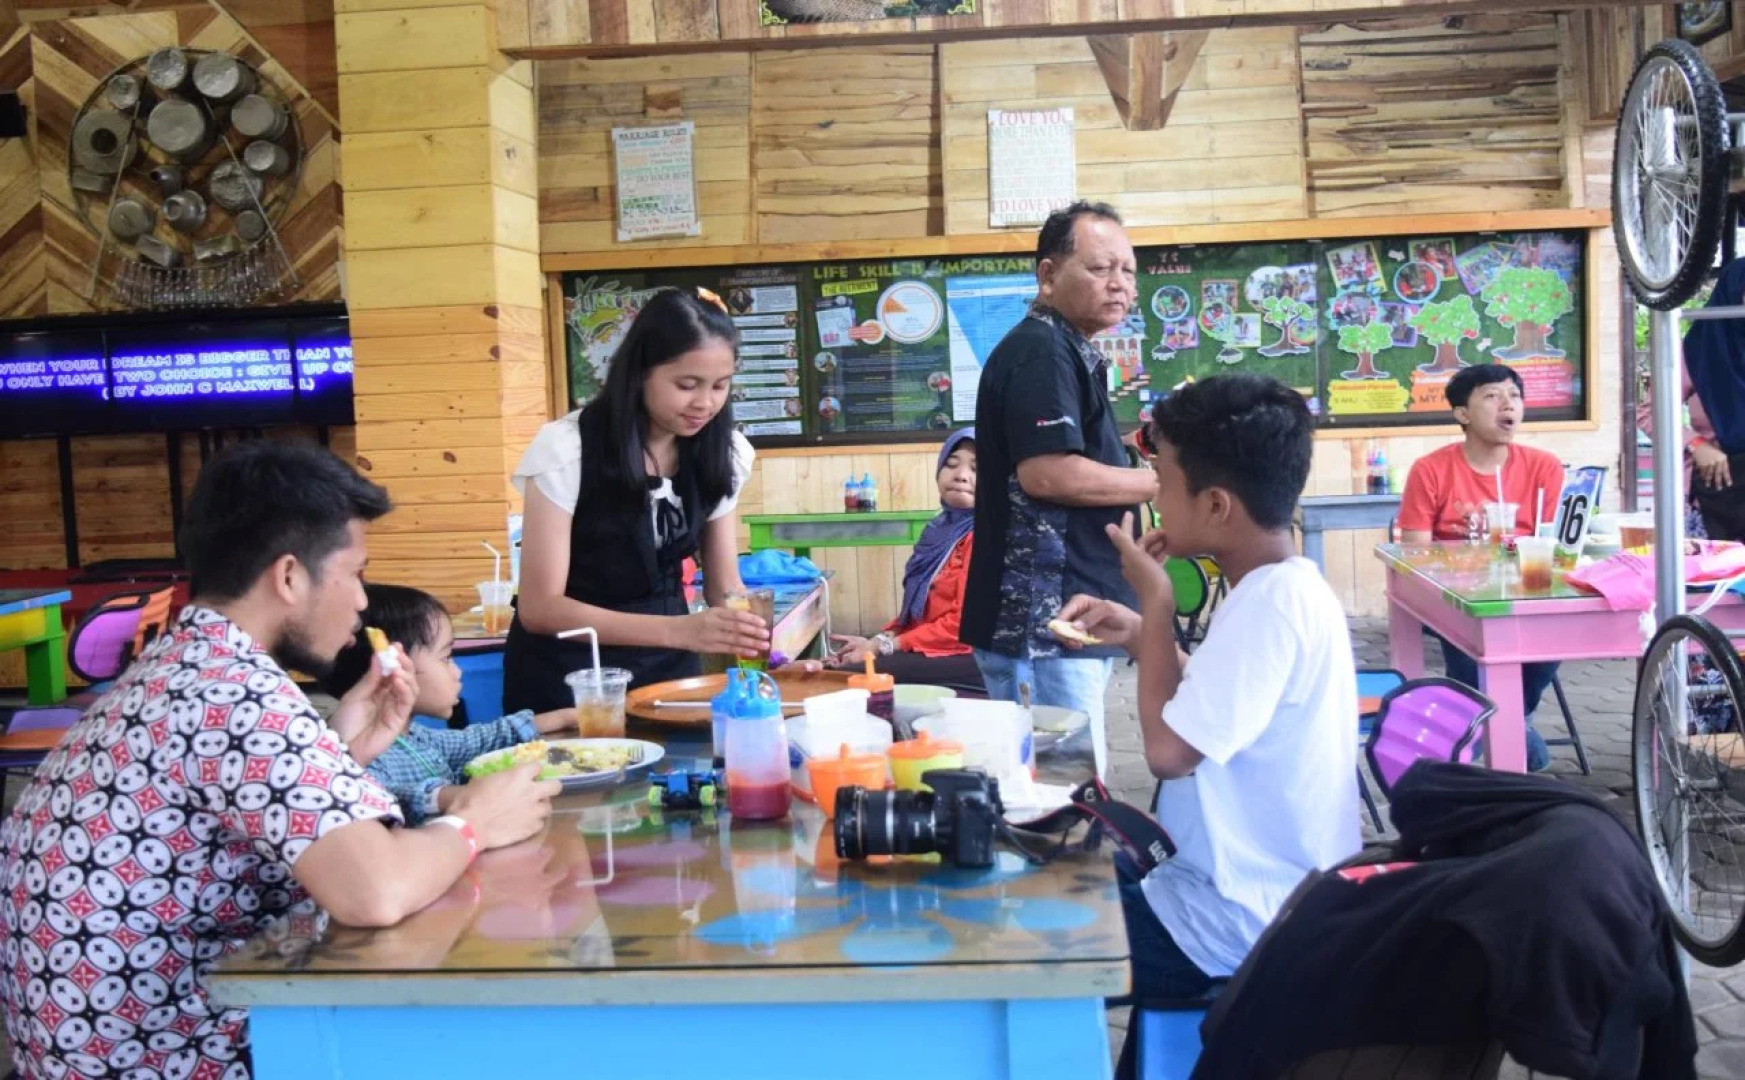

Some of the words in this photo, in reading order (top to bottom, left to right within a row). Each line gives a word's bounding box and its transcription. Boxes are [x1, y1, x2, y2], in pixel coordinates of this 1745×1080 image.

[814, 266, 848, 279] LIFE
[859, 263, 901, 277] SKILL
[940, 258, 1036, 273] IMPORTAN
[49, 359, 99, 372] YOUR
[199, 350, 270, 364] BIGGER
[7, 376, 54, 390] ONLY
[57, 373, 105, 387] HAVE
[113, 370, 156, 383] TWO
[302, 363, 329, 375] UP
[141, 382, 194, 397] JOHN
[1558, 494, 1588, 545] 16
